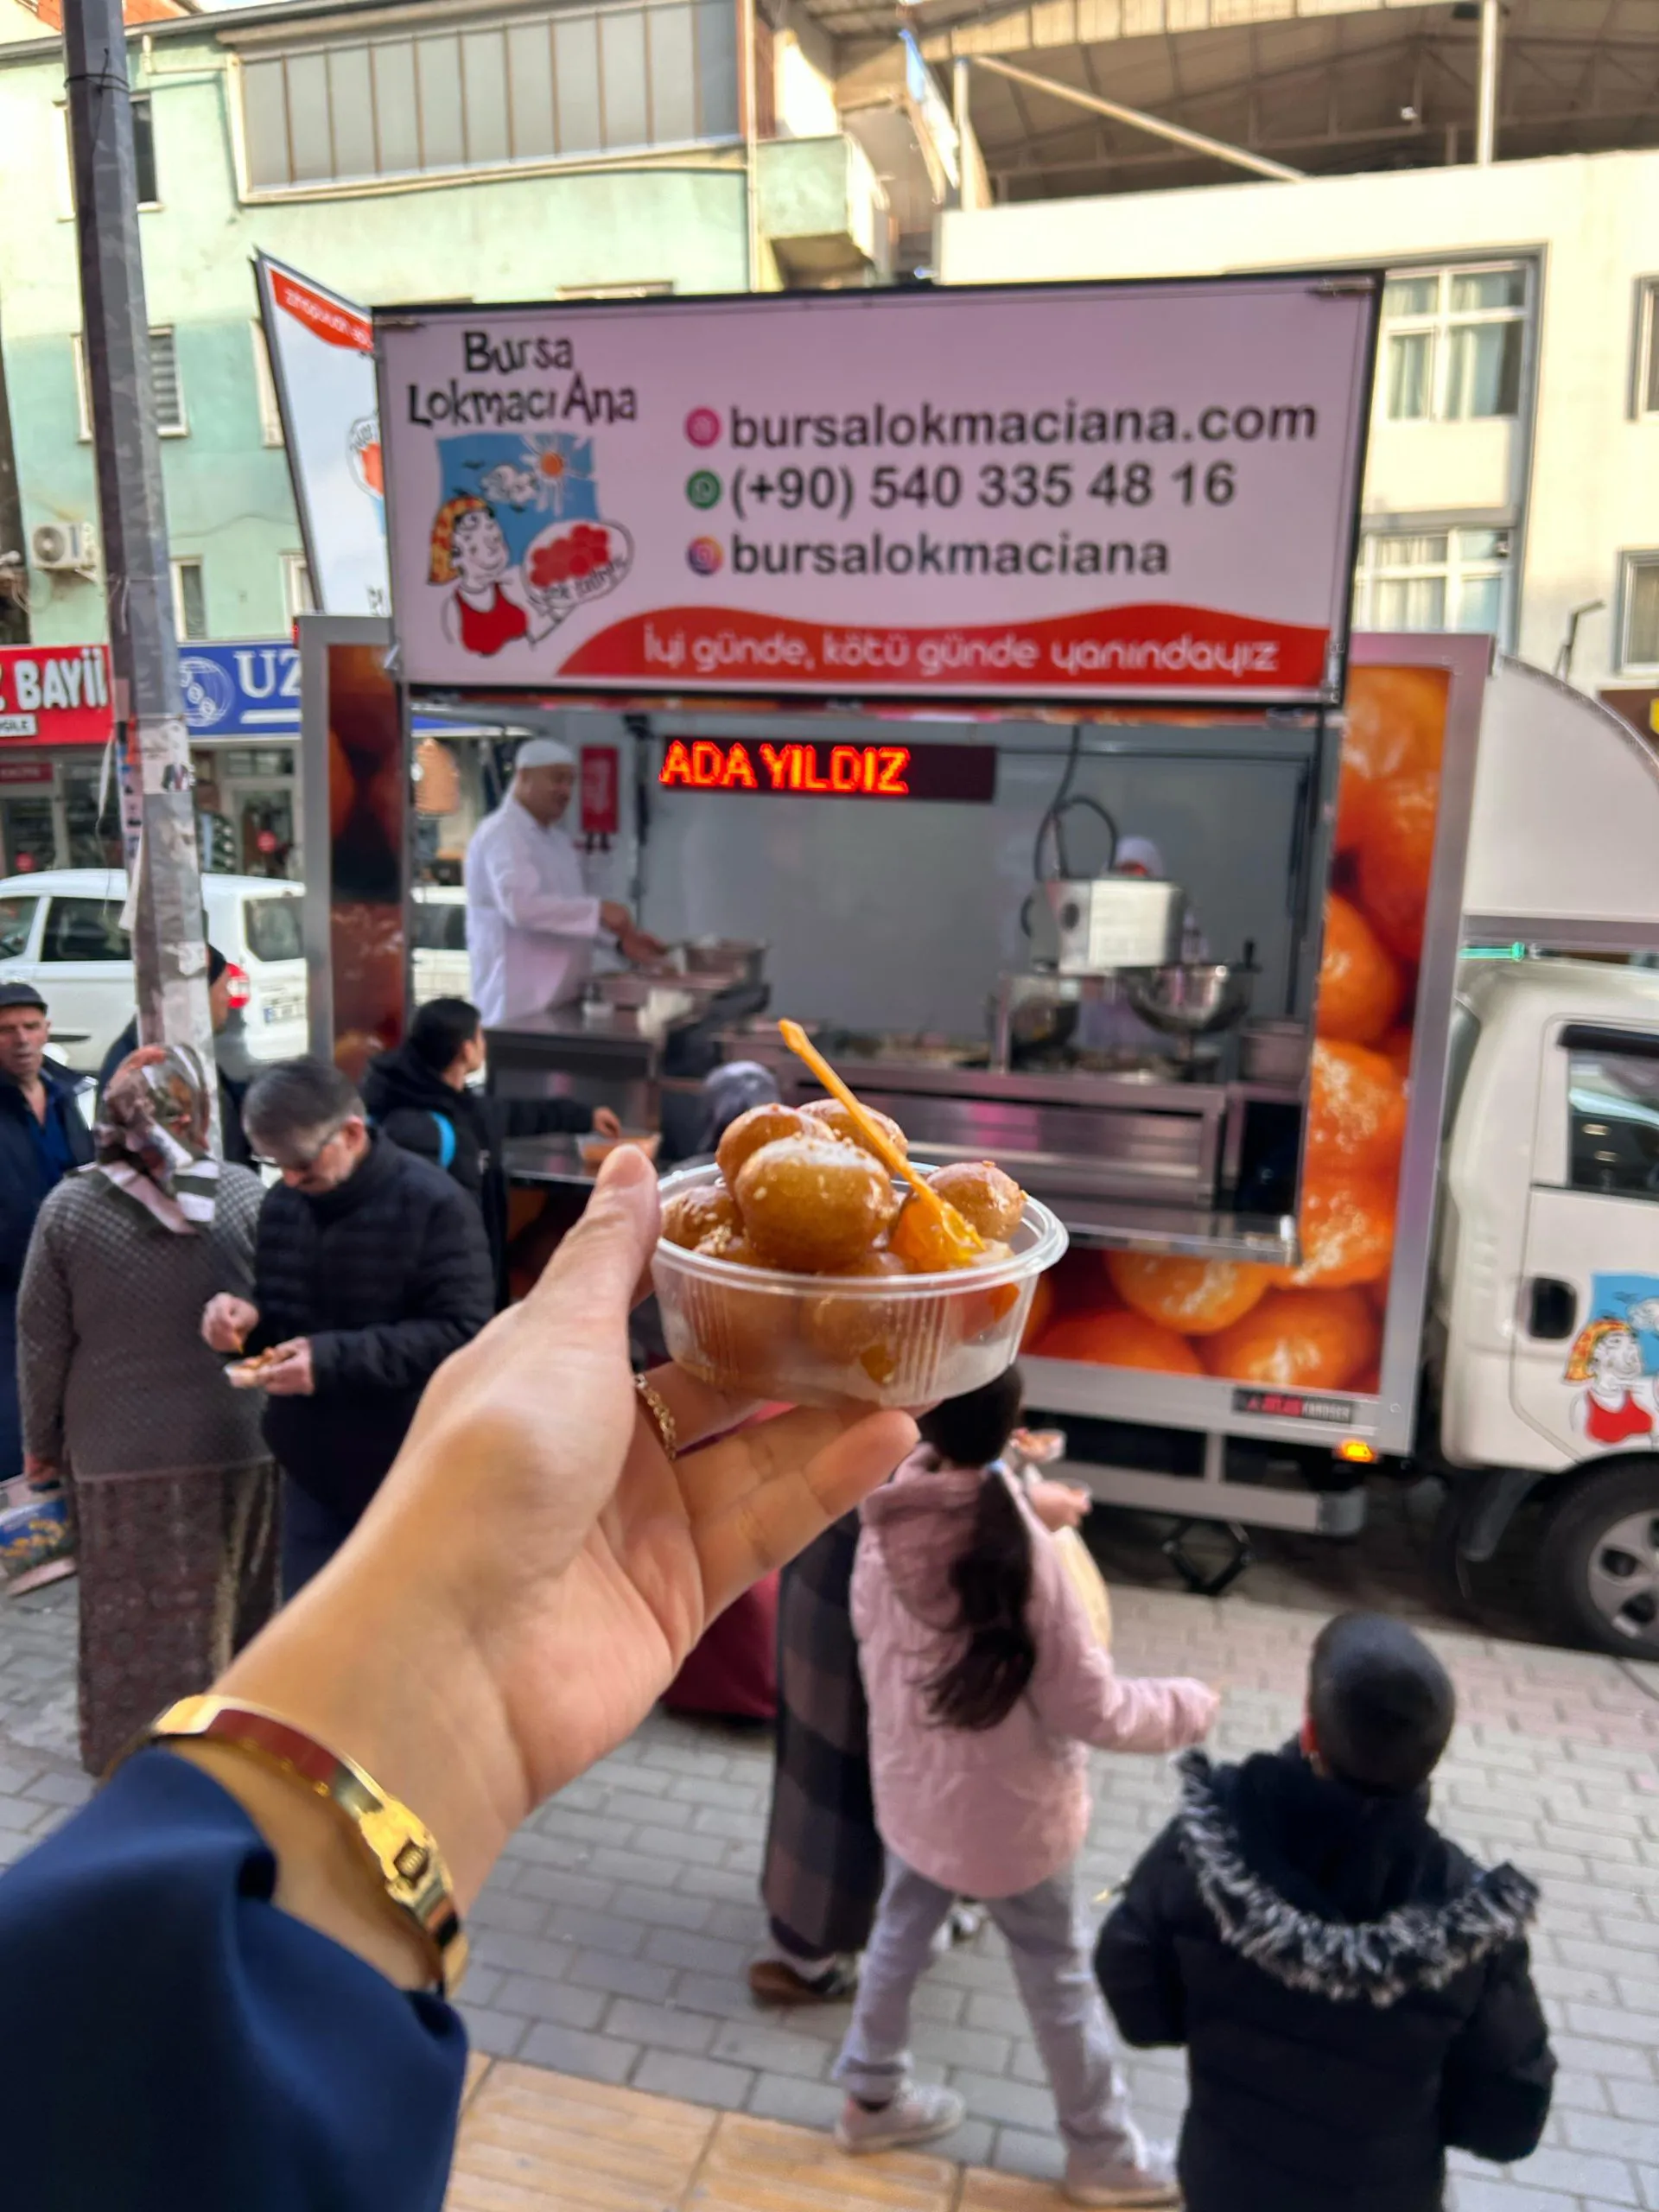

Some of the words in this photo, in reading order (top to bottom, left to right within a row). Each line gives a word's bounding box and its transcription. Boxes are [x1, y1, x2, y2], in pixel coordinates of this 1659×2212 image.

[464, 331, 574, 375] Bursa
[409, 378, 557, 428] Lokmacı
[563, 370, 638, 425] Ana
[731, 398, 1317, 448] bursalokmaciana.com
[730, 464, 855, 520] (+90)
[870, 464, 962, 509] 540
[977, 461, 1073, 508] 335
[1087, 460, 1153, 507] 48
[1172, 460, 1236, 506] 16
[732, 529, 1170, 575] bursalokmaciana
[691, 630, 816, 673] günde,
[823, 630, 909, 668] kötü
[917, 631, 1039, 677] günde
[1050, 632, 1280, 677] yanındayız
[658, 740, 757, 790] ADA
[759, 743, 910, 795] YILDIZ
